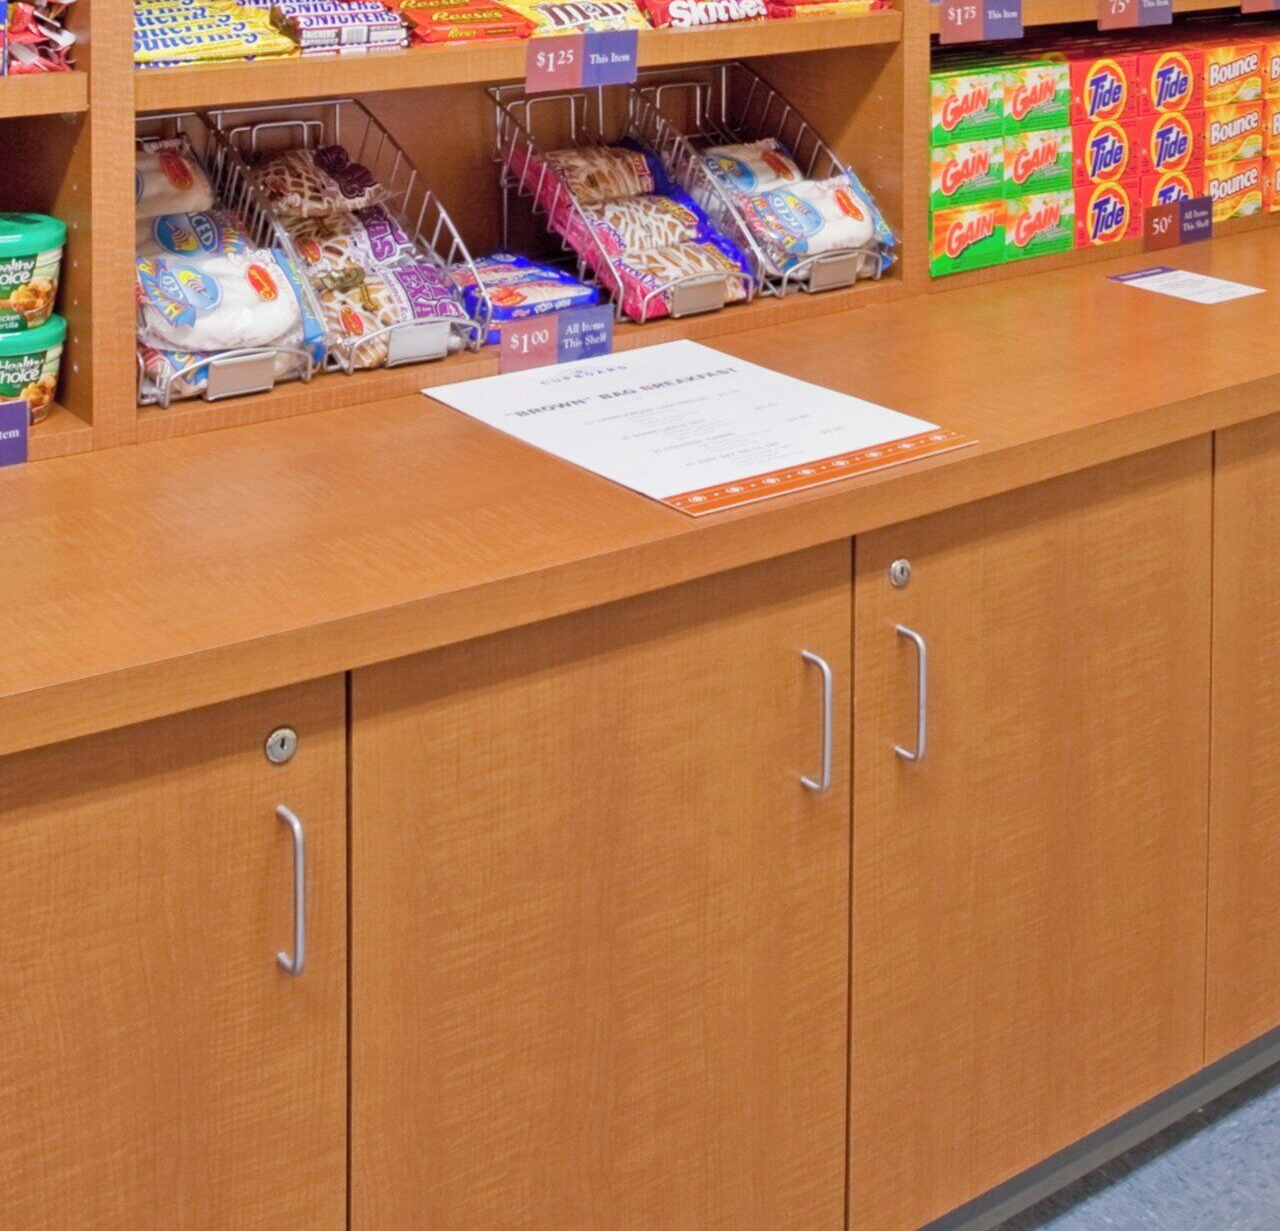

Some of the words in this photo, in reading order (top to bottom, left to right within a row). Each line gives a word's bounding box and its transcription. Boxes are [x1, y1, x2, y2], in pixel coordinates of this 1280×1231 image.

[302, 12, 398, 26] SNICKERS
[590, 54, 609, 65] This
[611, 52, 630, 63] Item
[1209, 53, 1258, 87] Bounce
[941, 85, 989, 131] GAIN
[1012, 78, 1056, 120] GAIN
[1089, 71, 1122, 116] Tide
[1090, 133, 1124, 178] Tide
[1092, 195, 1125, 240] Tide
[562, 337, 582, 348] This
[585, 333, 607, 347] Shelf
[565, 322, 579, 334] All
[581, 319, 605, 333] Items
[599, 387, 637, 400] BAG
[640, 367, 737, 391] BREAKFAST
